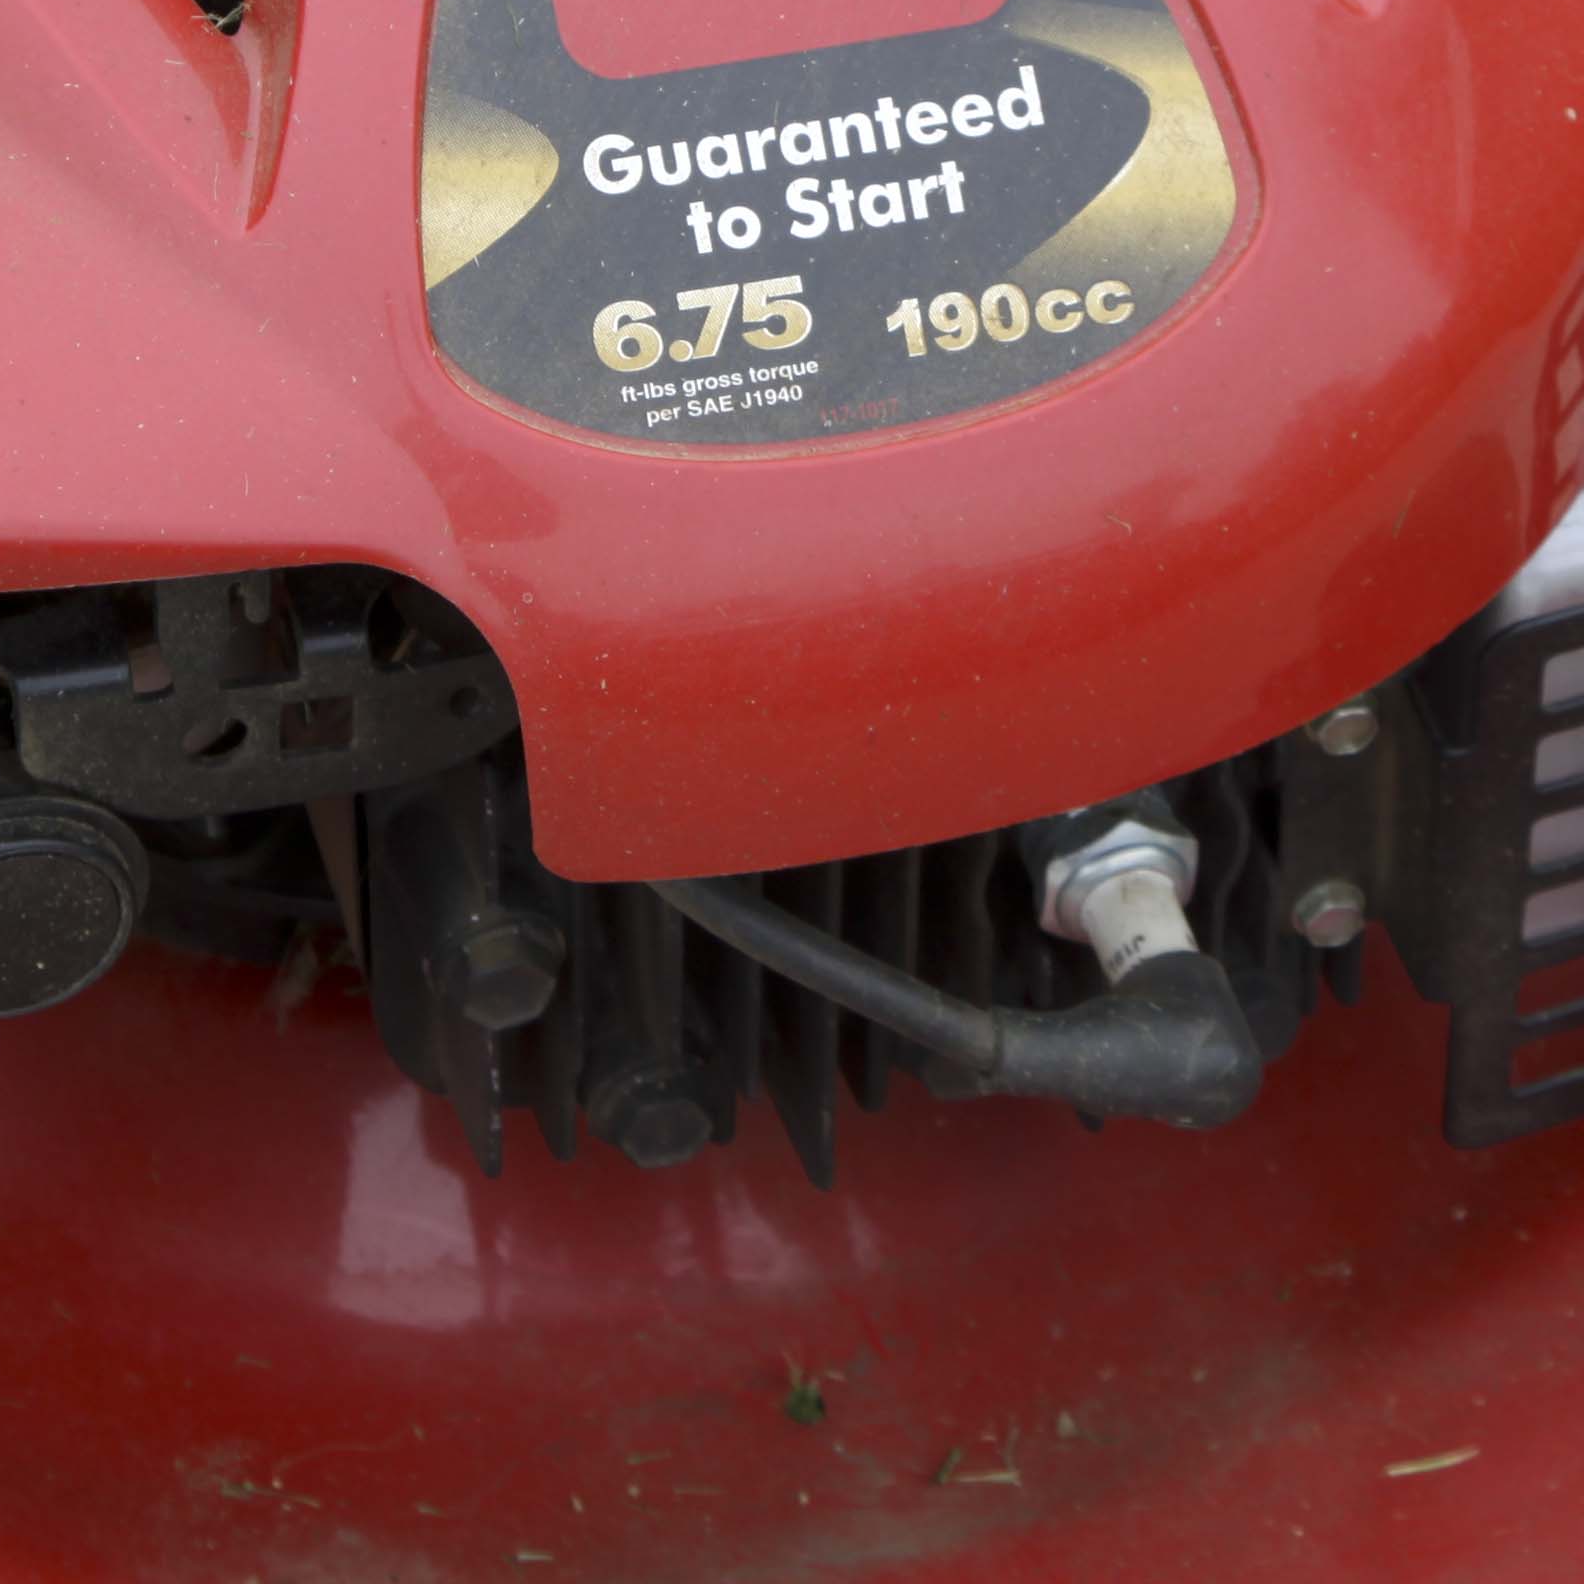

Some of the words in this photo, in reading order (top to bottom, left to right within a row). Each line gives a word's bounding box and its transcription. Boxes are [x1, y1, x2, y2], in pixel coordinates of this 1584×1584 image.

[583, 64, 1045, 195] Guaranteed
[685, 201, 762, 255] to
[785, 160, 965, 239] Start
[592, 274, 814, 373] 6.75
[887, 280, 1136, 358] 190cc
[619, 381, 678, 404] ft-lbs
[682, 372, 744, 398] gross
[749, 359, 820, 383] torque
[646, 405, 682, 429] per
[686, 394, 735, 418] SAE
[740, 384, 804, 410] J1940
